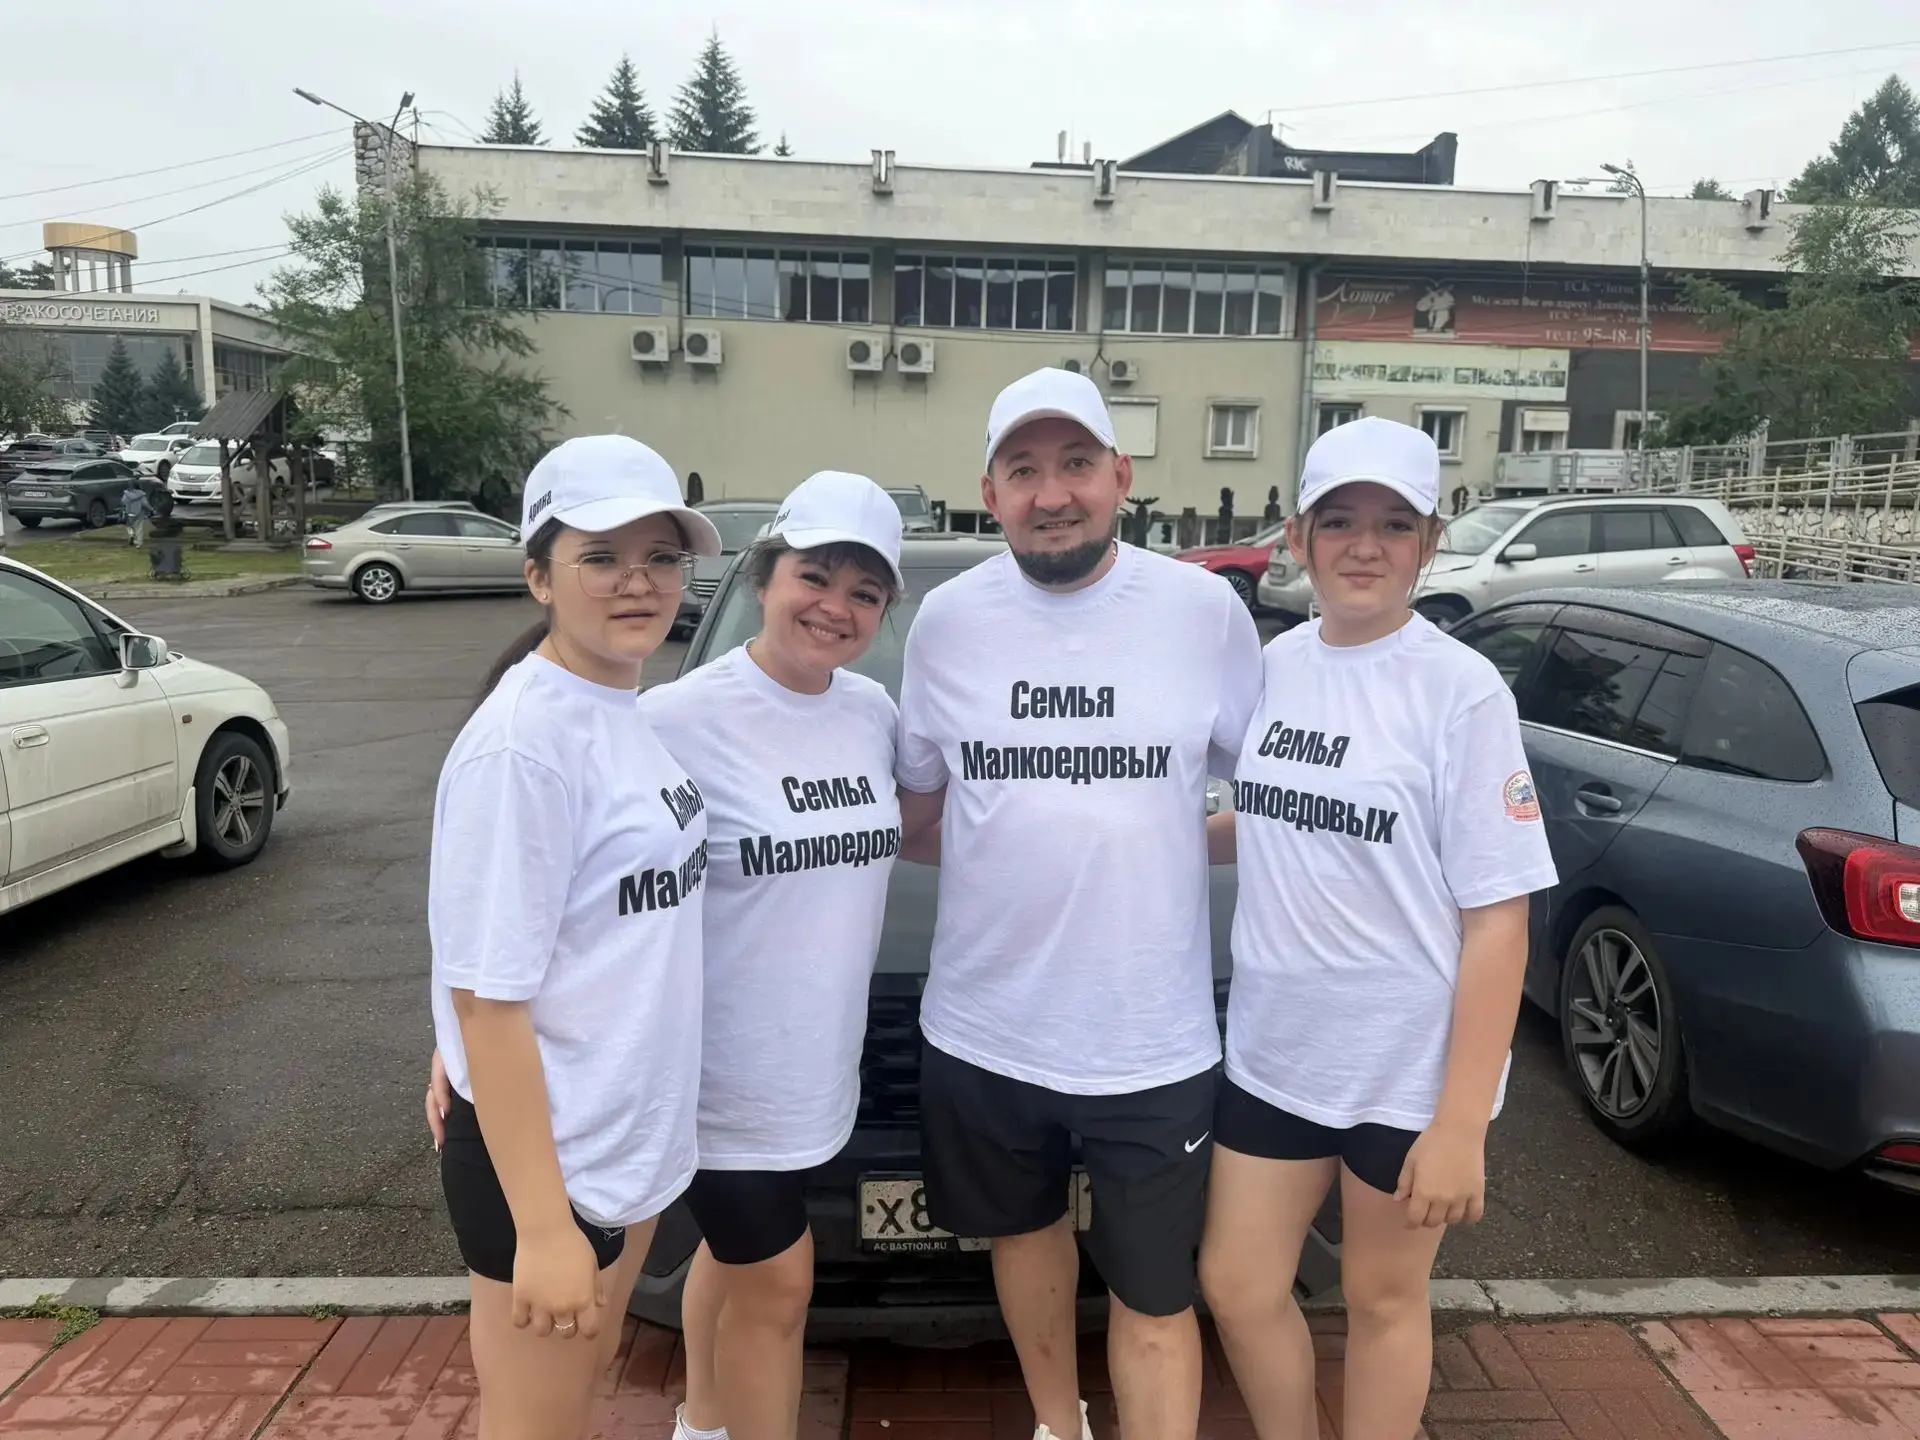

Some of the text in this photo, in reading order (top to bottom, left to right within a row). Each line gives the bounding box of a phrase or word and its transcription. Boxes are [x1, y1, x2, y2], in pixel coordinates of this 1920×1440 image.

[5, 304, 159, 323] БРАКОСОЧЕТАНИЯ
[529, 489, 552, 525] Арина
[1010, 680, 1115, 720] Семья
[960, 740, 1172, 784] Малкоедовых
[1258, 720, 1351, 768] Семья
[781, 775, 877, 814] Семья
[1233, 778, 1399, 844] алкоедовых
[739, 826, 900, 877] Малкоедов
